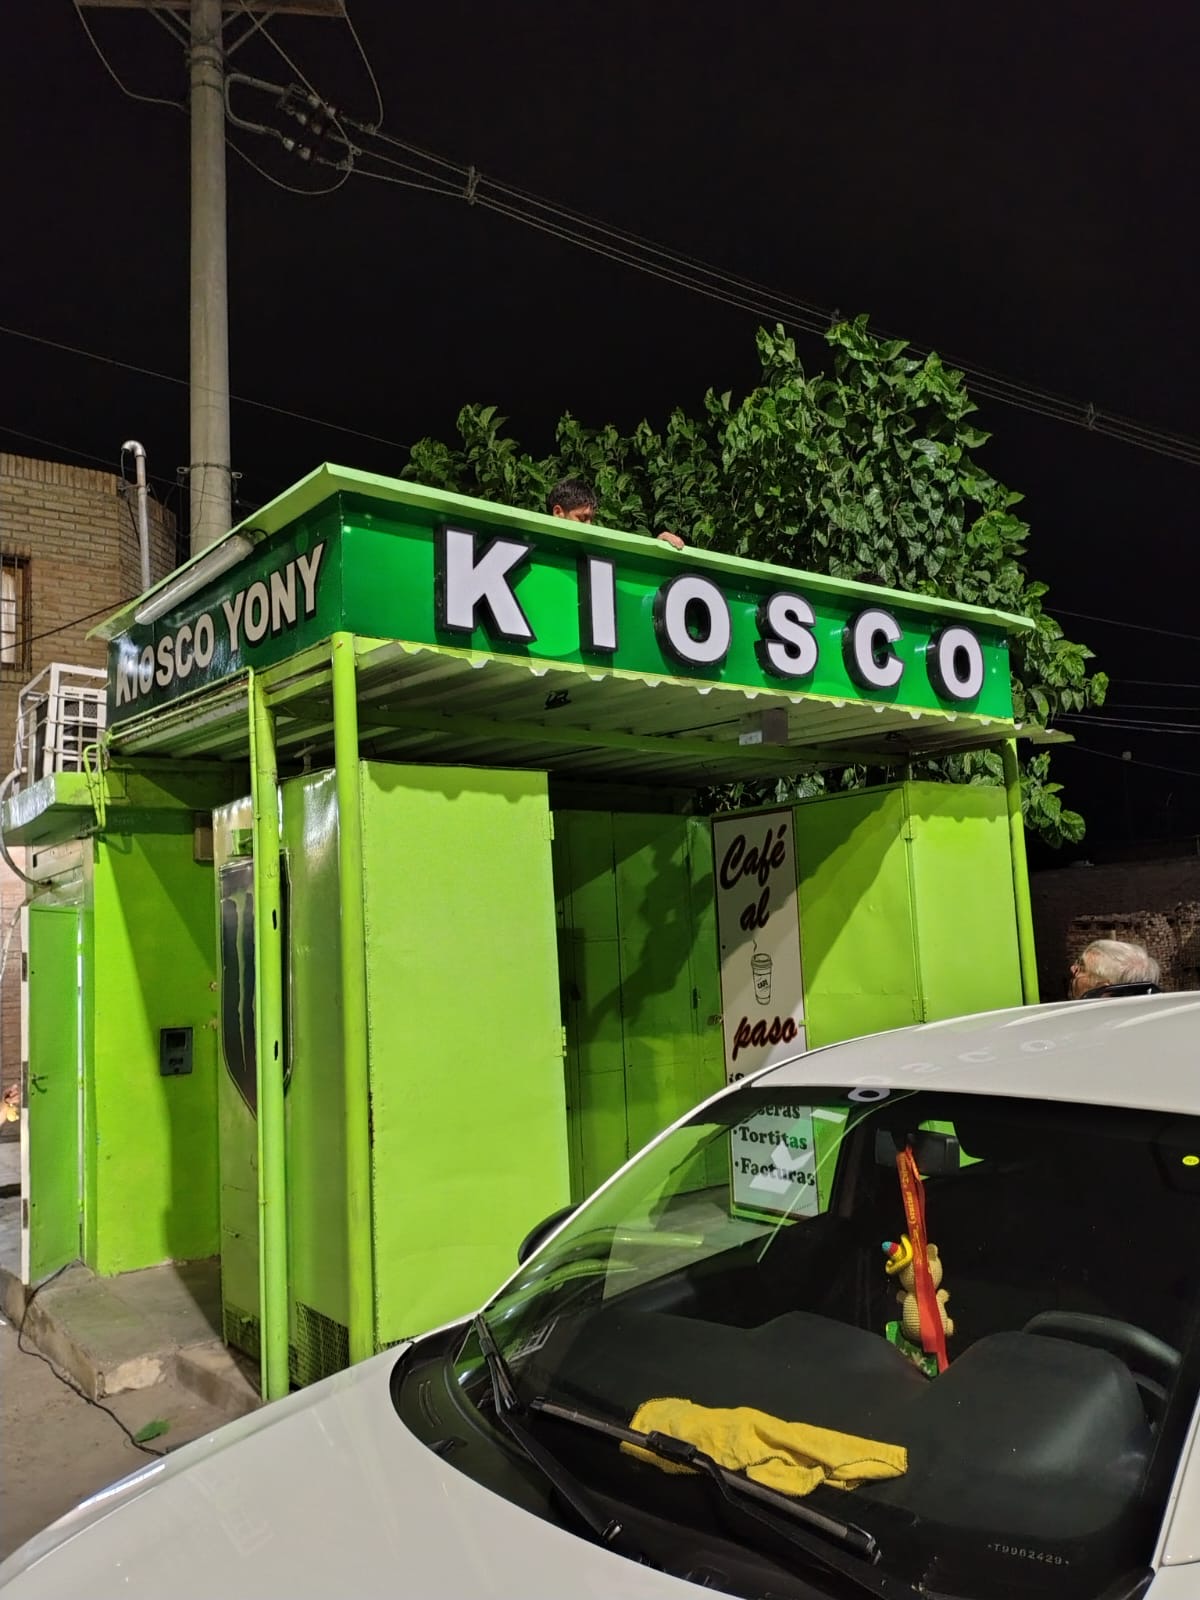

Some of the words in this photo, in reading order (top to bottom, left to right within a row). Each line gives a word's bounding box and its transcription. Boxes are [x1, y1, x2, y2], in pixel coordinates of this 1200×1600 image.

[115, 614, 214, 707] KIOSCO
[222, 543, 324, 652] YONY
[438, 526, 985, 699] KIOSCO
[720, 823, 788, 891] Café
[740, 886, 770, 931] al
[732, 1014, 799, 1062] paso
